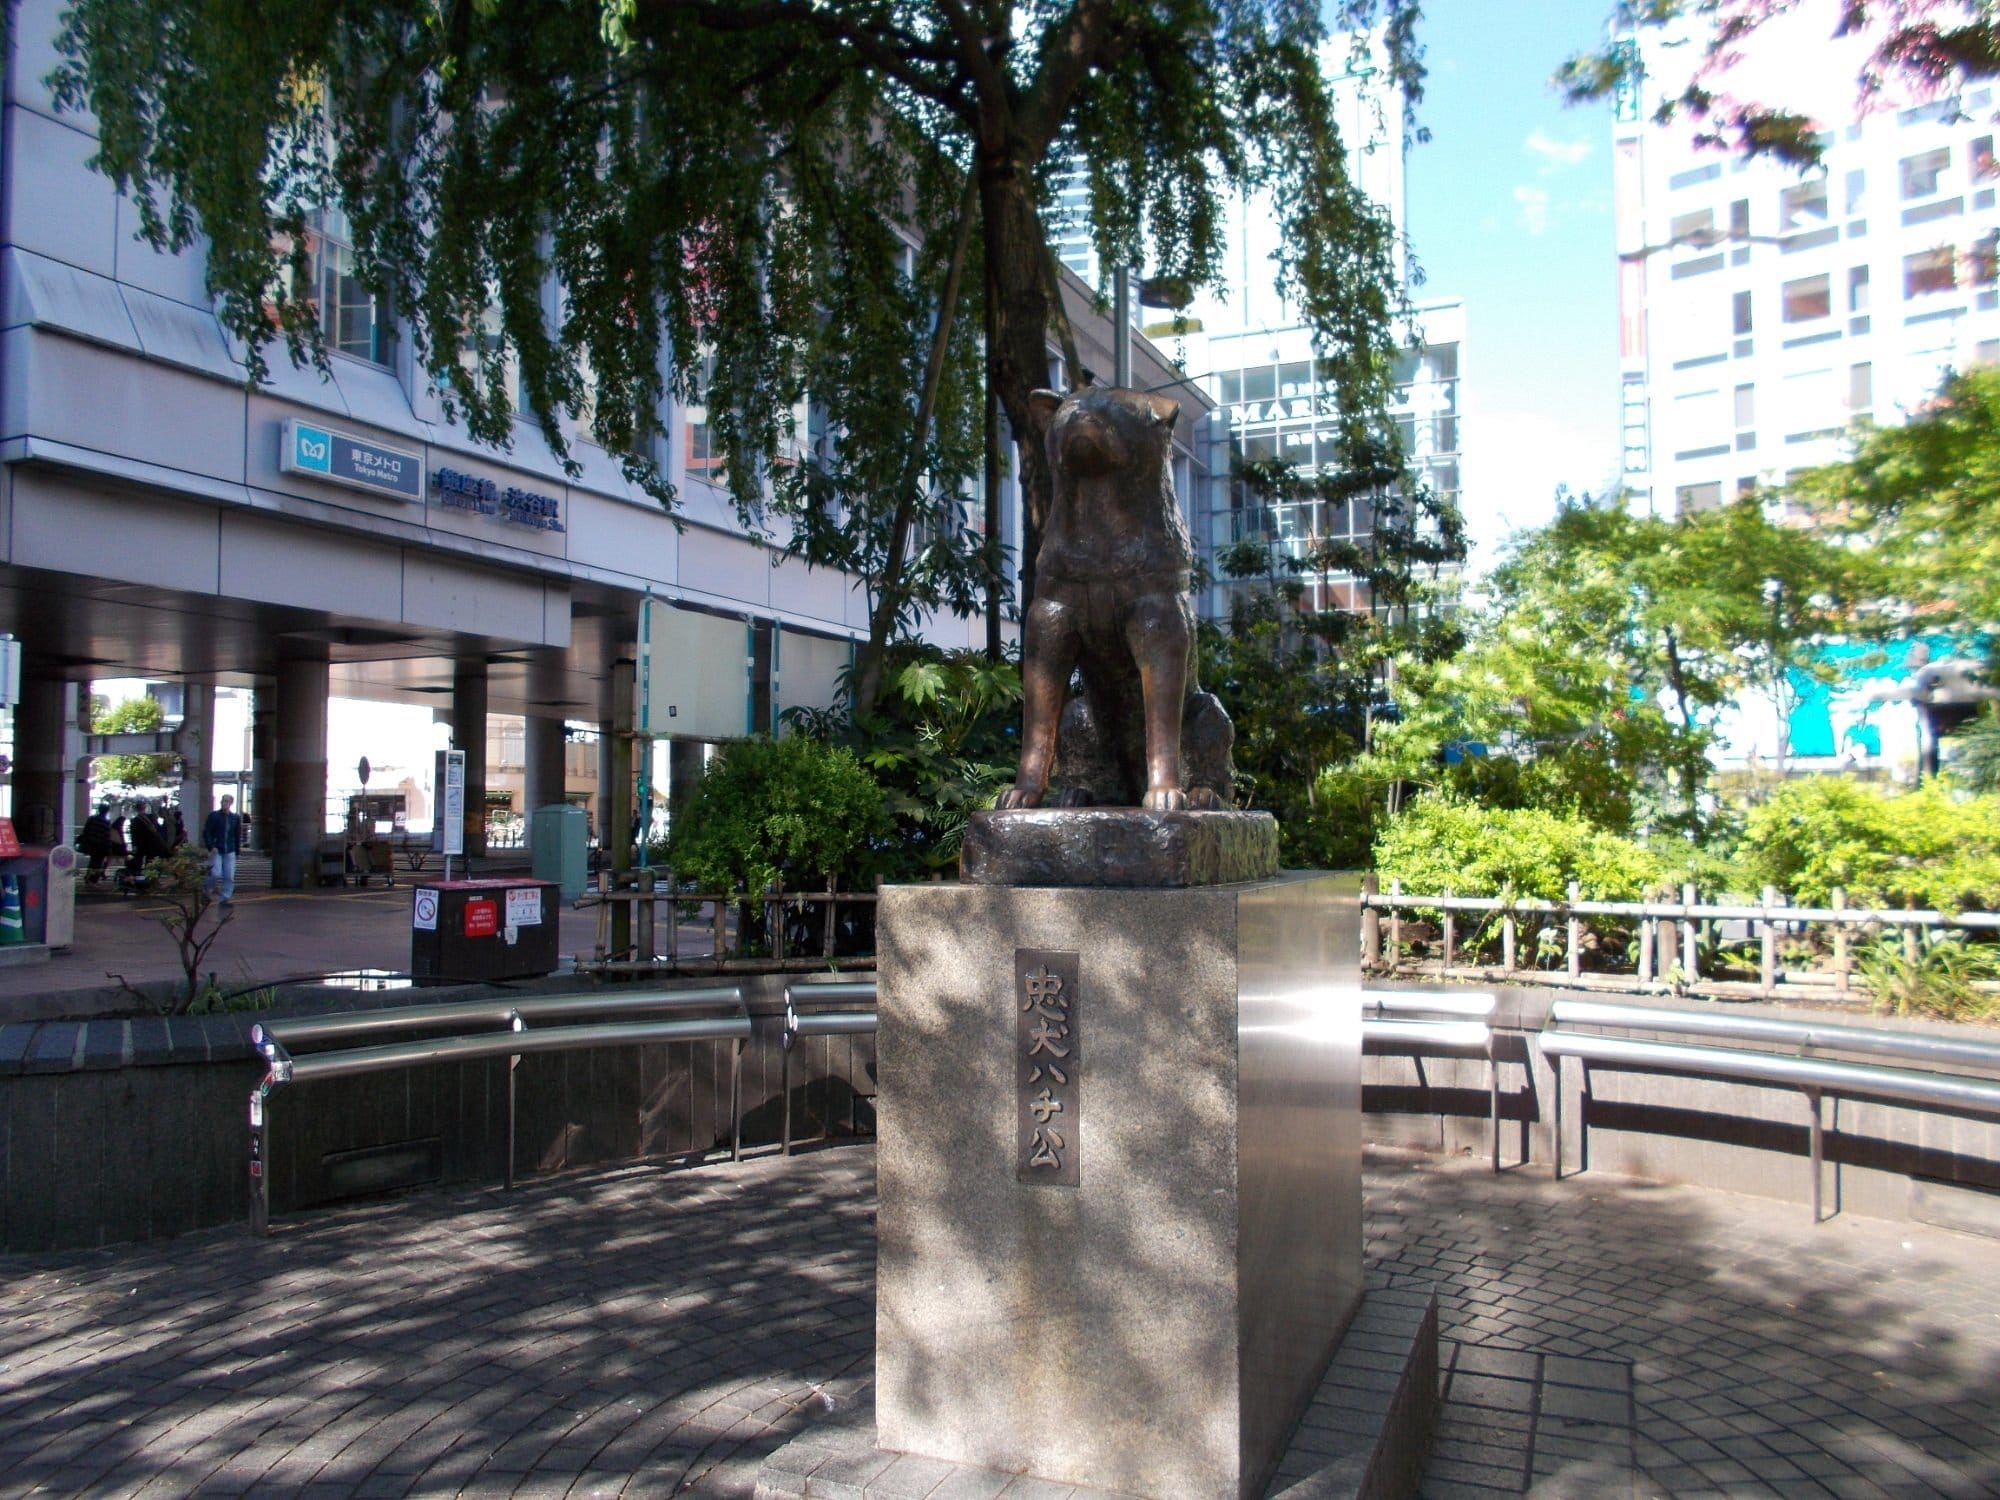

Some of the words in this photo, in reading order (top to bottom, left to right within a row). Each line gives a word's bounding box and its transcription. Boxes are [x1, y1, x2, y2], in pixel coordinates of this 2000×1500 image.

[351, 448, 401, 473] 東京メトロ
[354, 463, 376, 477] Tokyo
[377, 467, 399, 483] Metro
[1022, 963, 1070, 1170] 忠犬ハチ公
